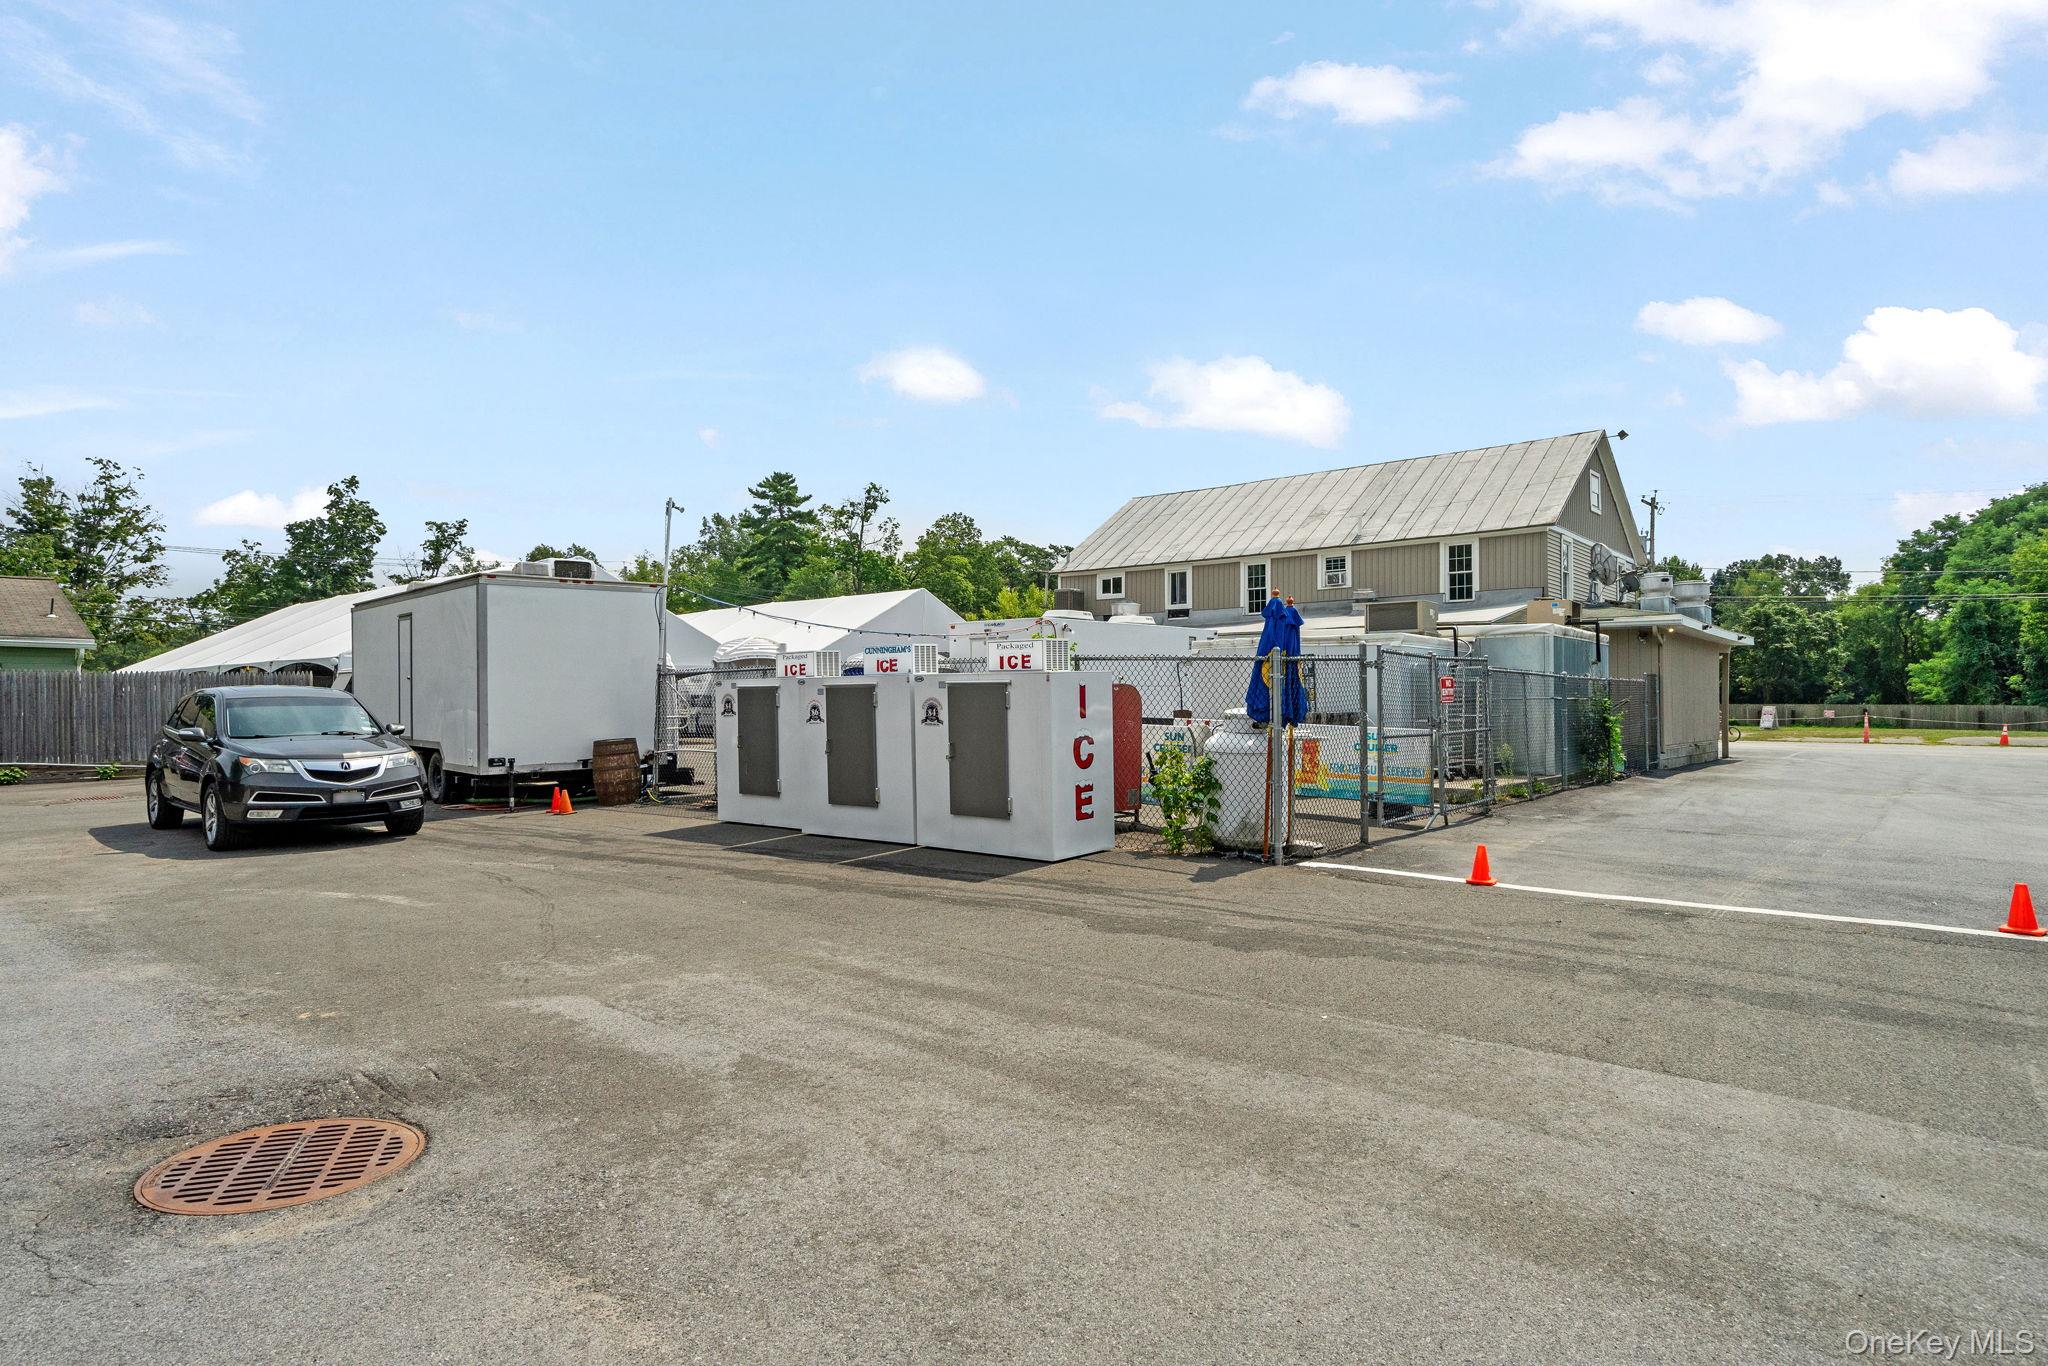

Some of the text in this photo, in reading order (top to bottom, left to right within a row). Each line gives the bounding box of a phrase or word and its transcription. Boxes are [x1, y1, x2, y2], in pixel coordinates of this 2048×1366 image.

[864, 645, 912, 655] CUNNINGHAM'S
[995, 642, 1034, 650] Packaged
[782, 653, 808, 661] Packaged
[999, 654, 1032, 670] ICE
[784, 663, 807, 677] ICE
[876, 658, 899, 673] ICE
[1164, 732, 1185, 741] SUN
[1073, 680, 1095, 821] ICE
